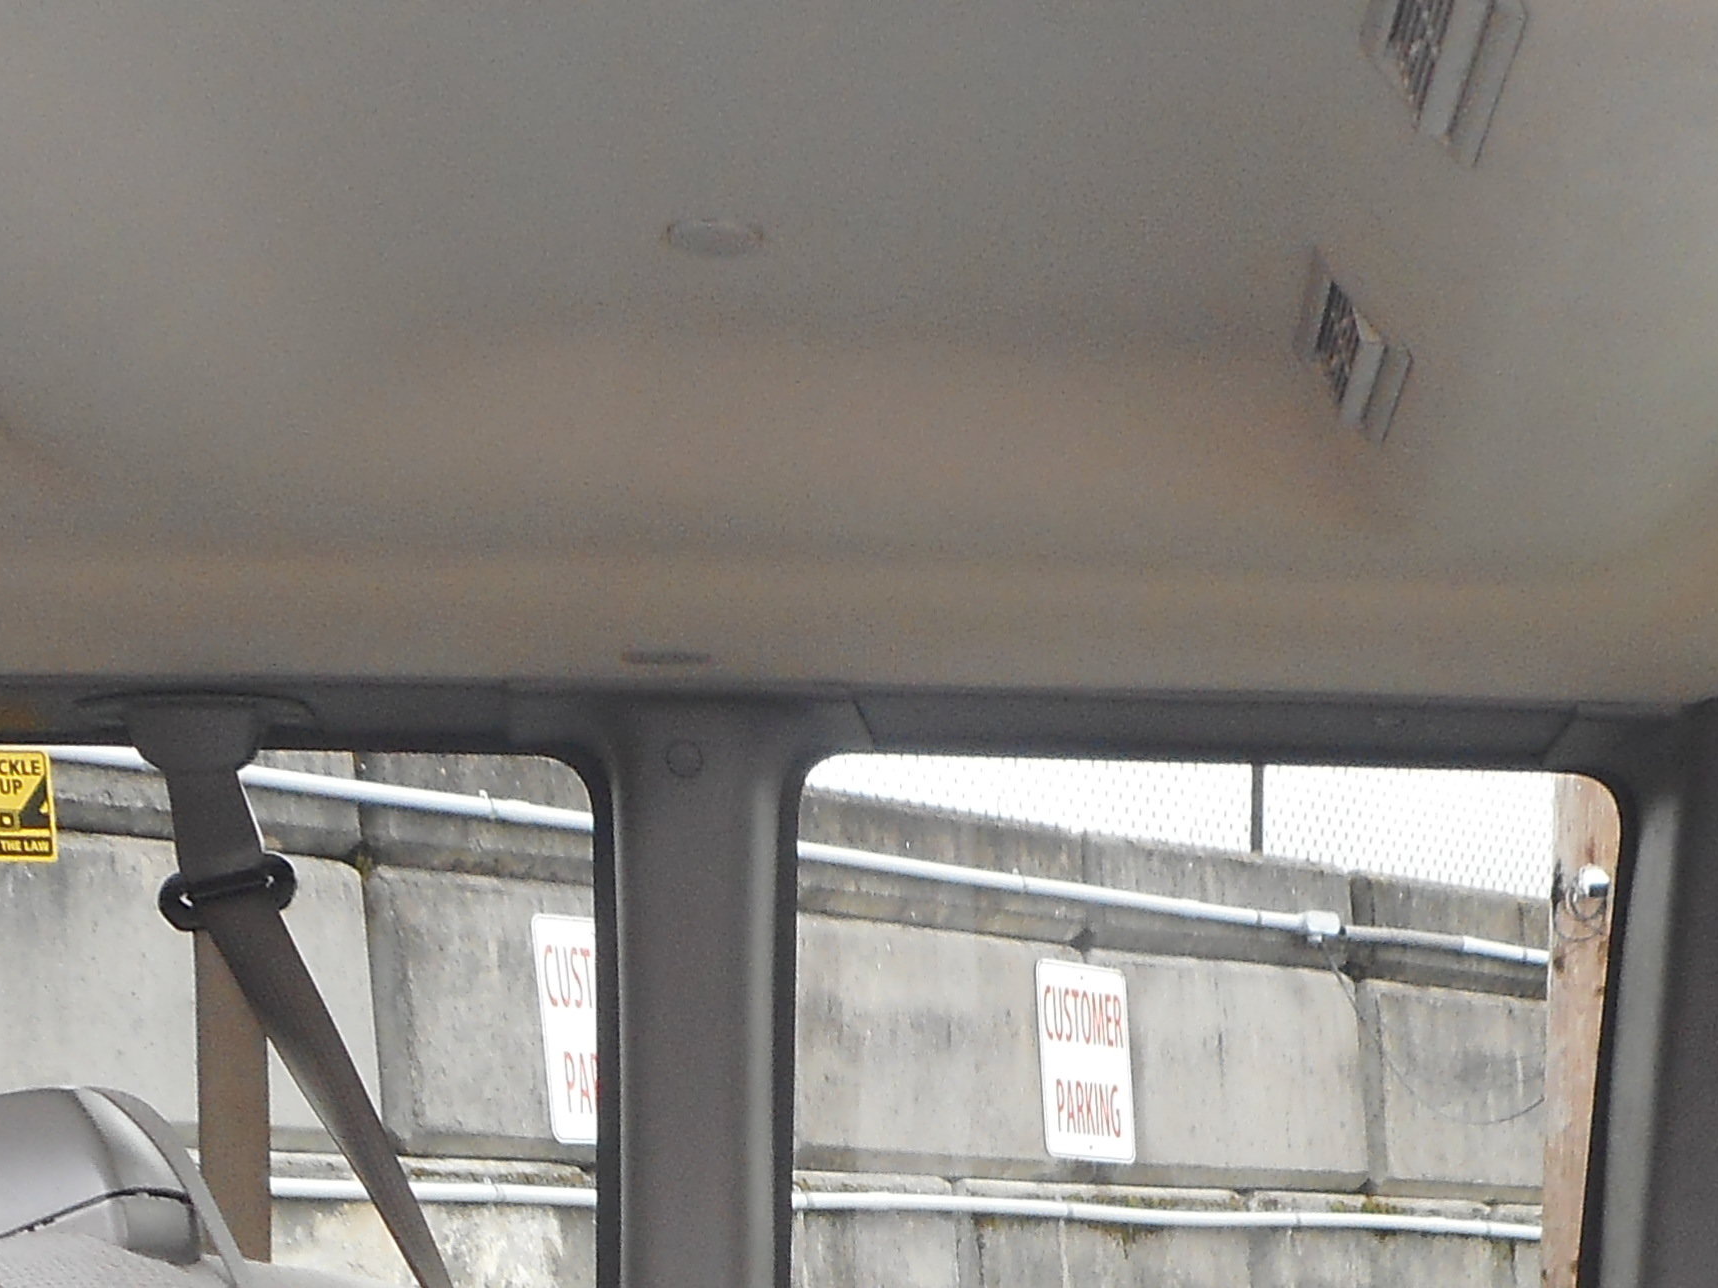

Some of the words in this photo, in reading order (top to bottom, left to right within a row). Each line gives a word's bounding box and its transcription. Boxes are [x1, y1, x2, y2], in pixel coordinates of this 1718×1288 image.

[2, 840, 21, 852] THE
[23, 840, 49, 853] LAW
[544, 944, 594, 1009] CUST
[1044, 985, 1124, 1048] CUSTOMER
[1056, 1078, 1121, 1138] PARKING
